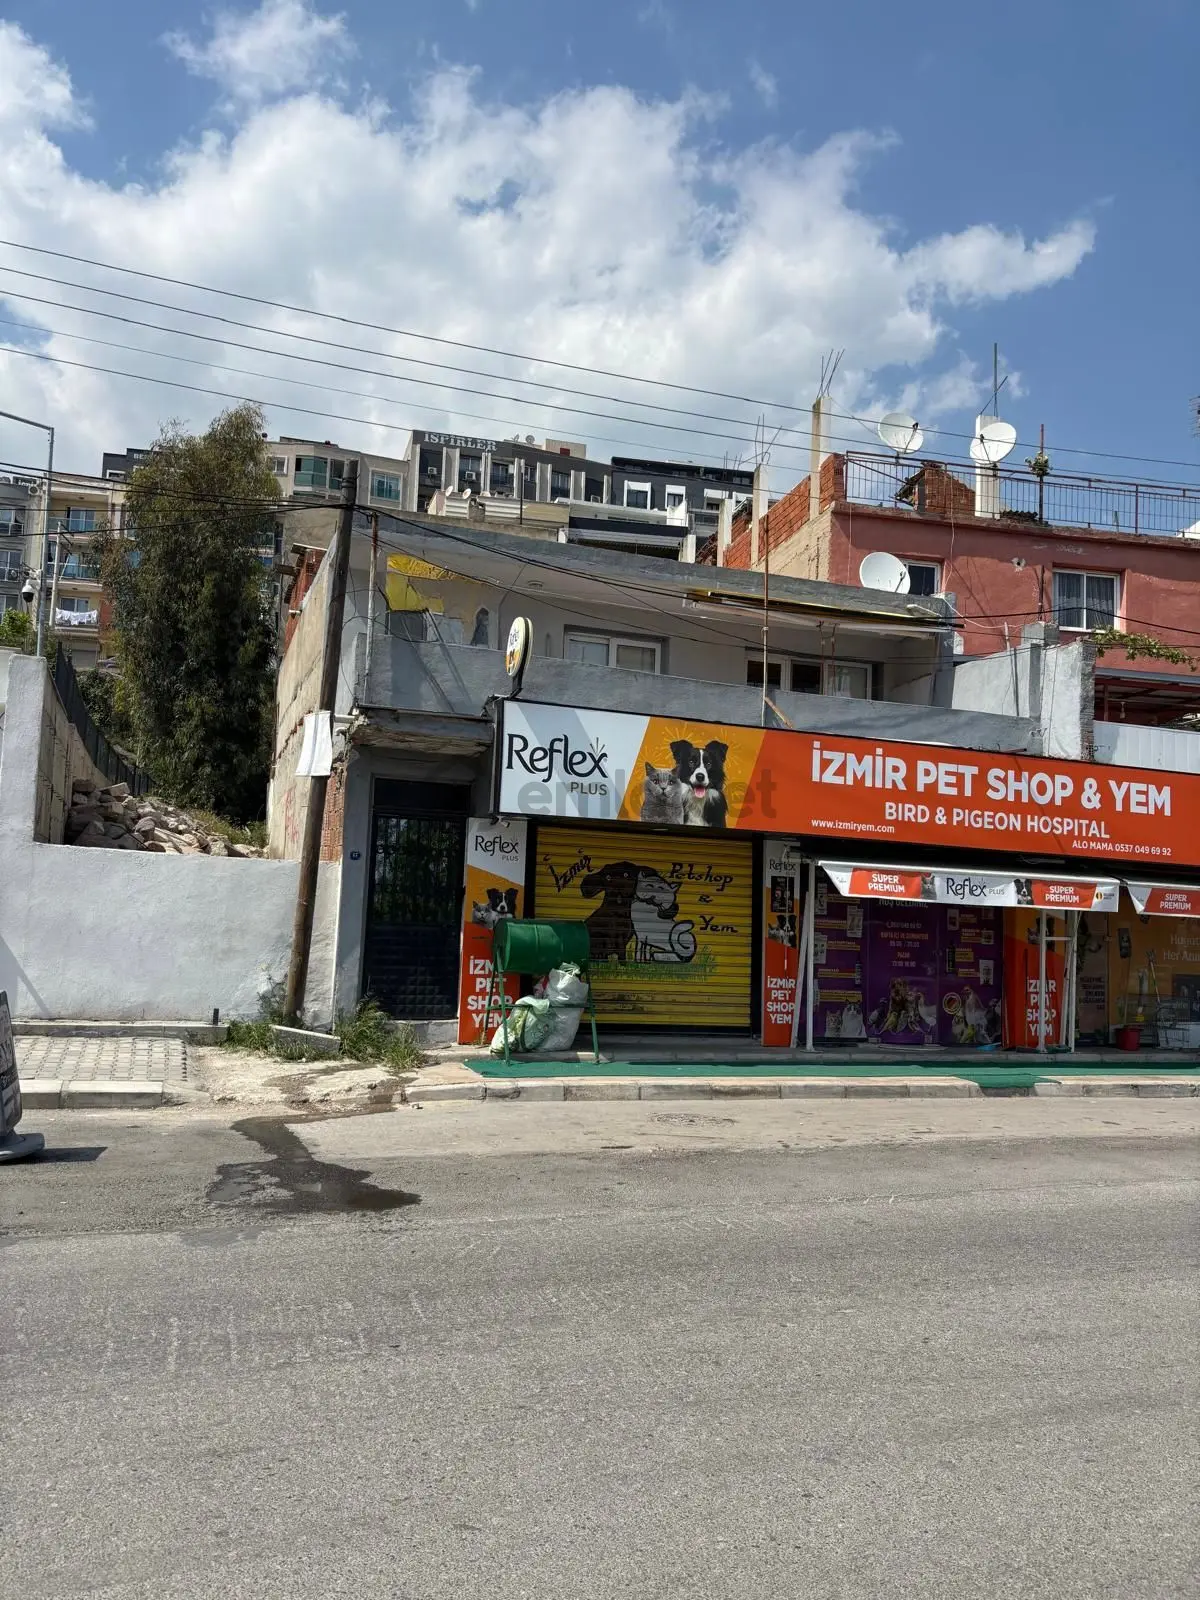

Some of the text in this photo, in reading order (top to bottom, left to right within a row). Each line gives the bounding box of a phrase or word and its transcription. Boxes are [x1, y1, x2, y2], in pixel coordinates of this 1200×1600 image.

[506, 733, 608, 783] Reflex
[812, 741, 1171, 816] İZMİR PET SHOP & YEM
[570, 782, 607, 796] PLUS
[811, 818, 895, 834] www.izmiryem.com
[885, 801, 1110, 839] BIRD & PIGEON HOSPITAL
[474, 834, 519, 856] Reflex
[1072, 840, 1172, 856] ALO MAMA 0537 049 69 92
[872, 873, 899, 884] SUPER
[868, 884, 905, 893] PREMIUM
[946, 877, 987, 900] Reflex
[1050, 885, 1074, 894] SUPER
[1045, 894, 1080, 903] PREMIUM
[1165, 893, 1187, 902] SUPER
[1160, 902, 1191, 911] PREMIUM
[699, 915, 738, 933] Yem
[772, 990, 791, 1000] PET
[770, 1014, 792, 1024] YEM
